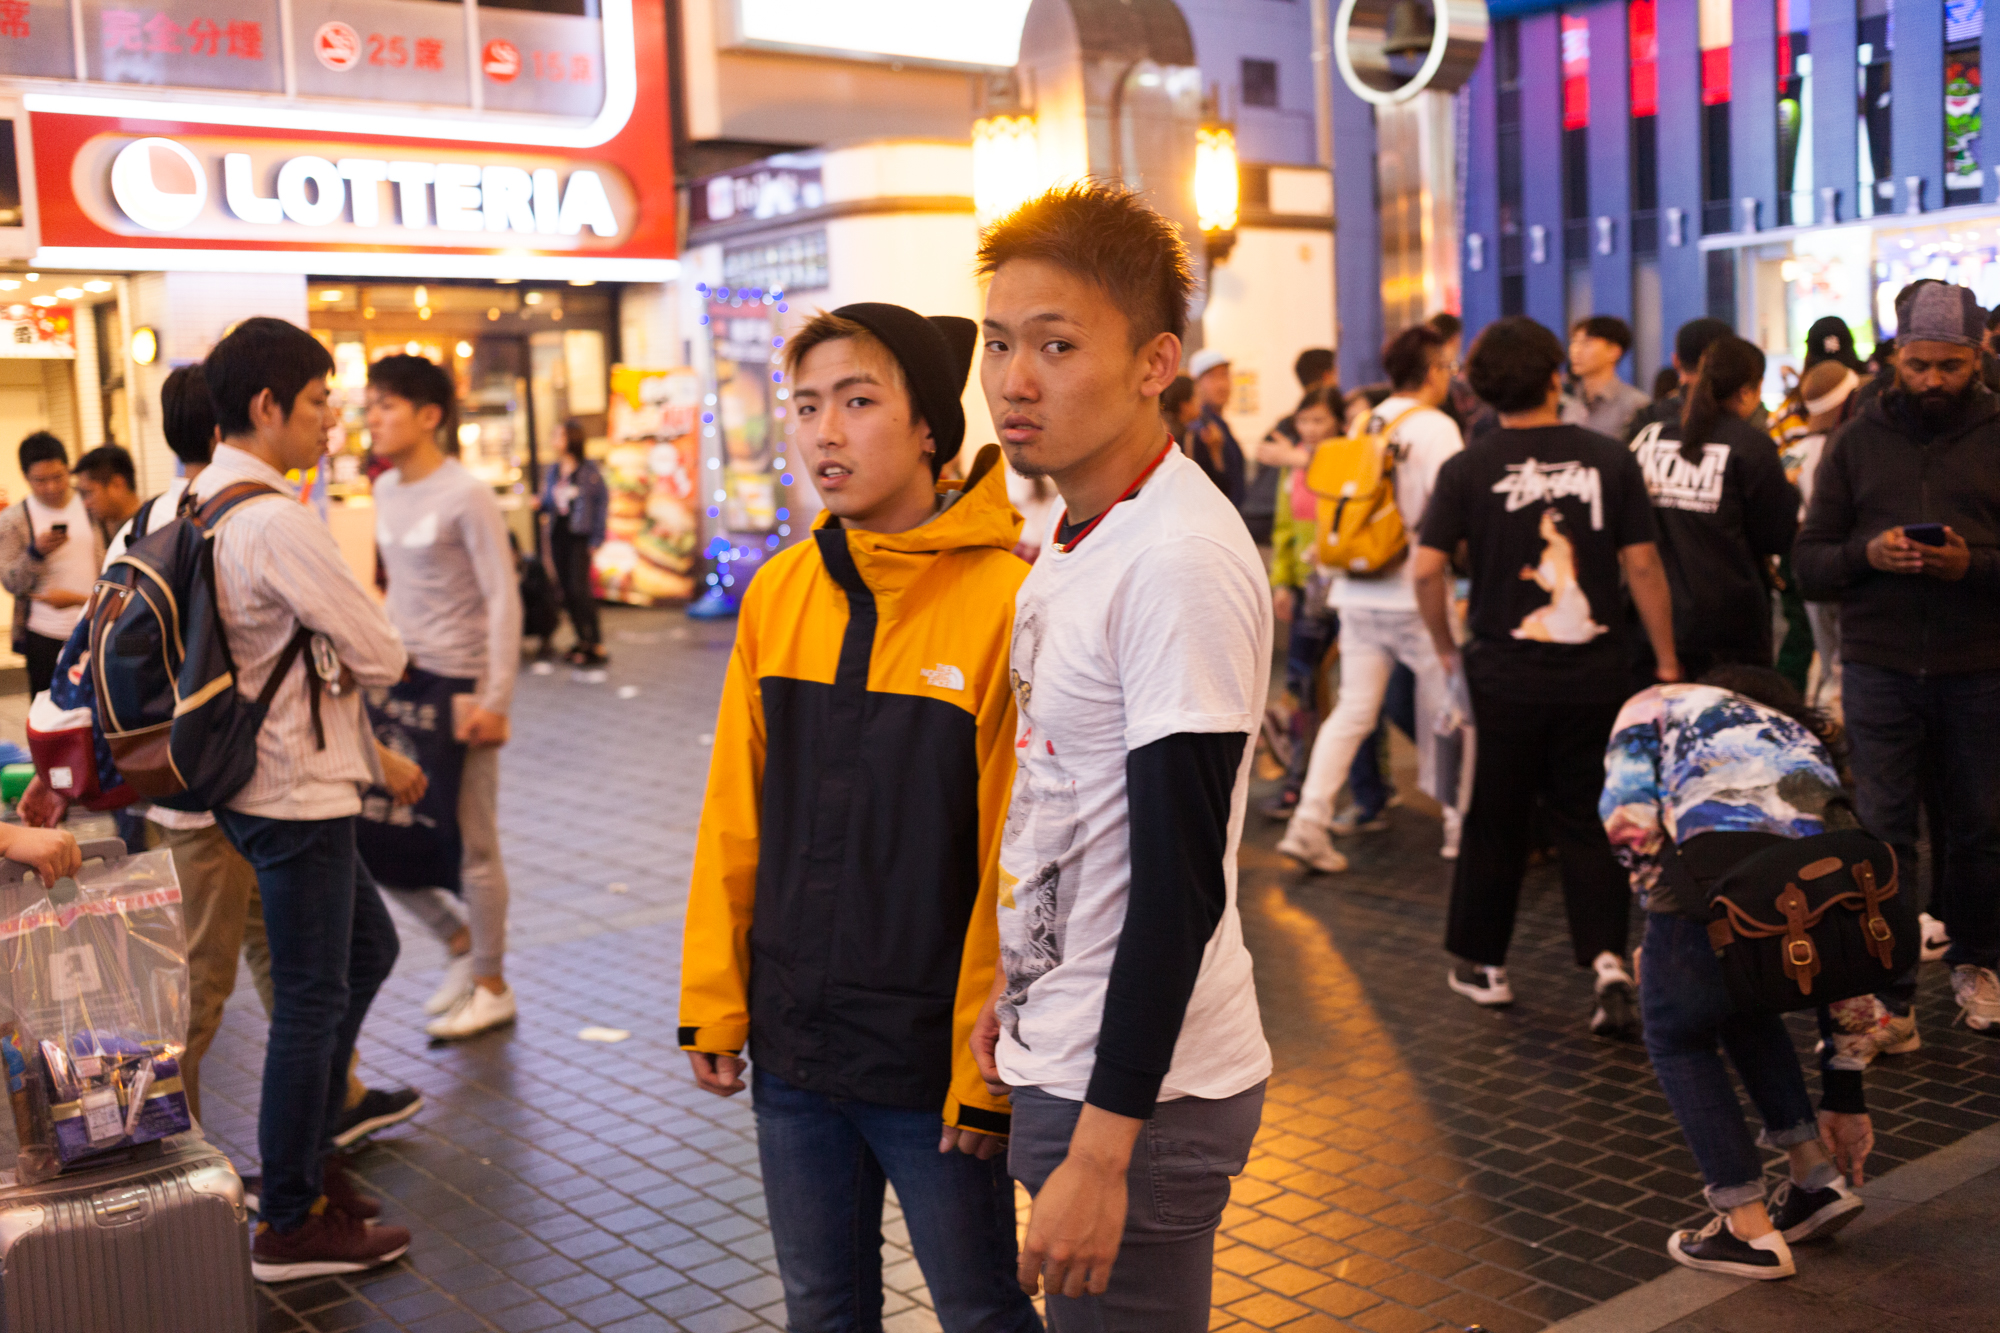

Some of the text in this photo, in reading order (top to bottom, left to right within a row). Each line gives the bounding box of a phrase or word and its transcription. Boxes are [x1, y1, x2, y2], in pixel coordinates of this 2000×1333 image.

[101, 9, 264, 61] 完全分煙
[224, 153, 618, 237] LOTTERIA
